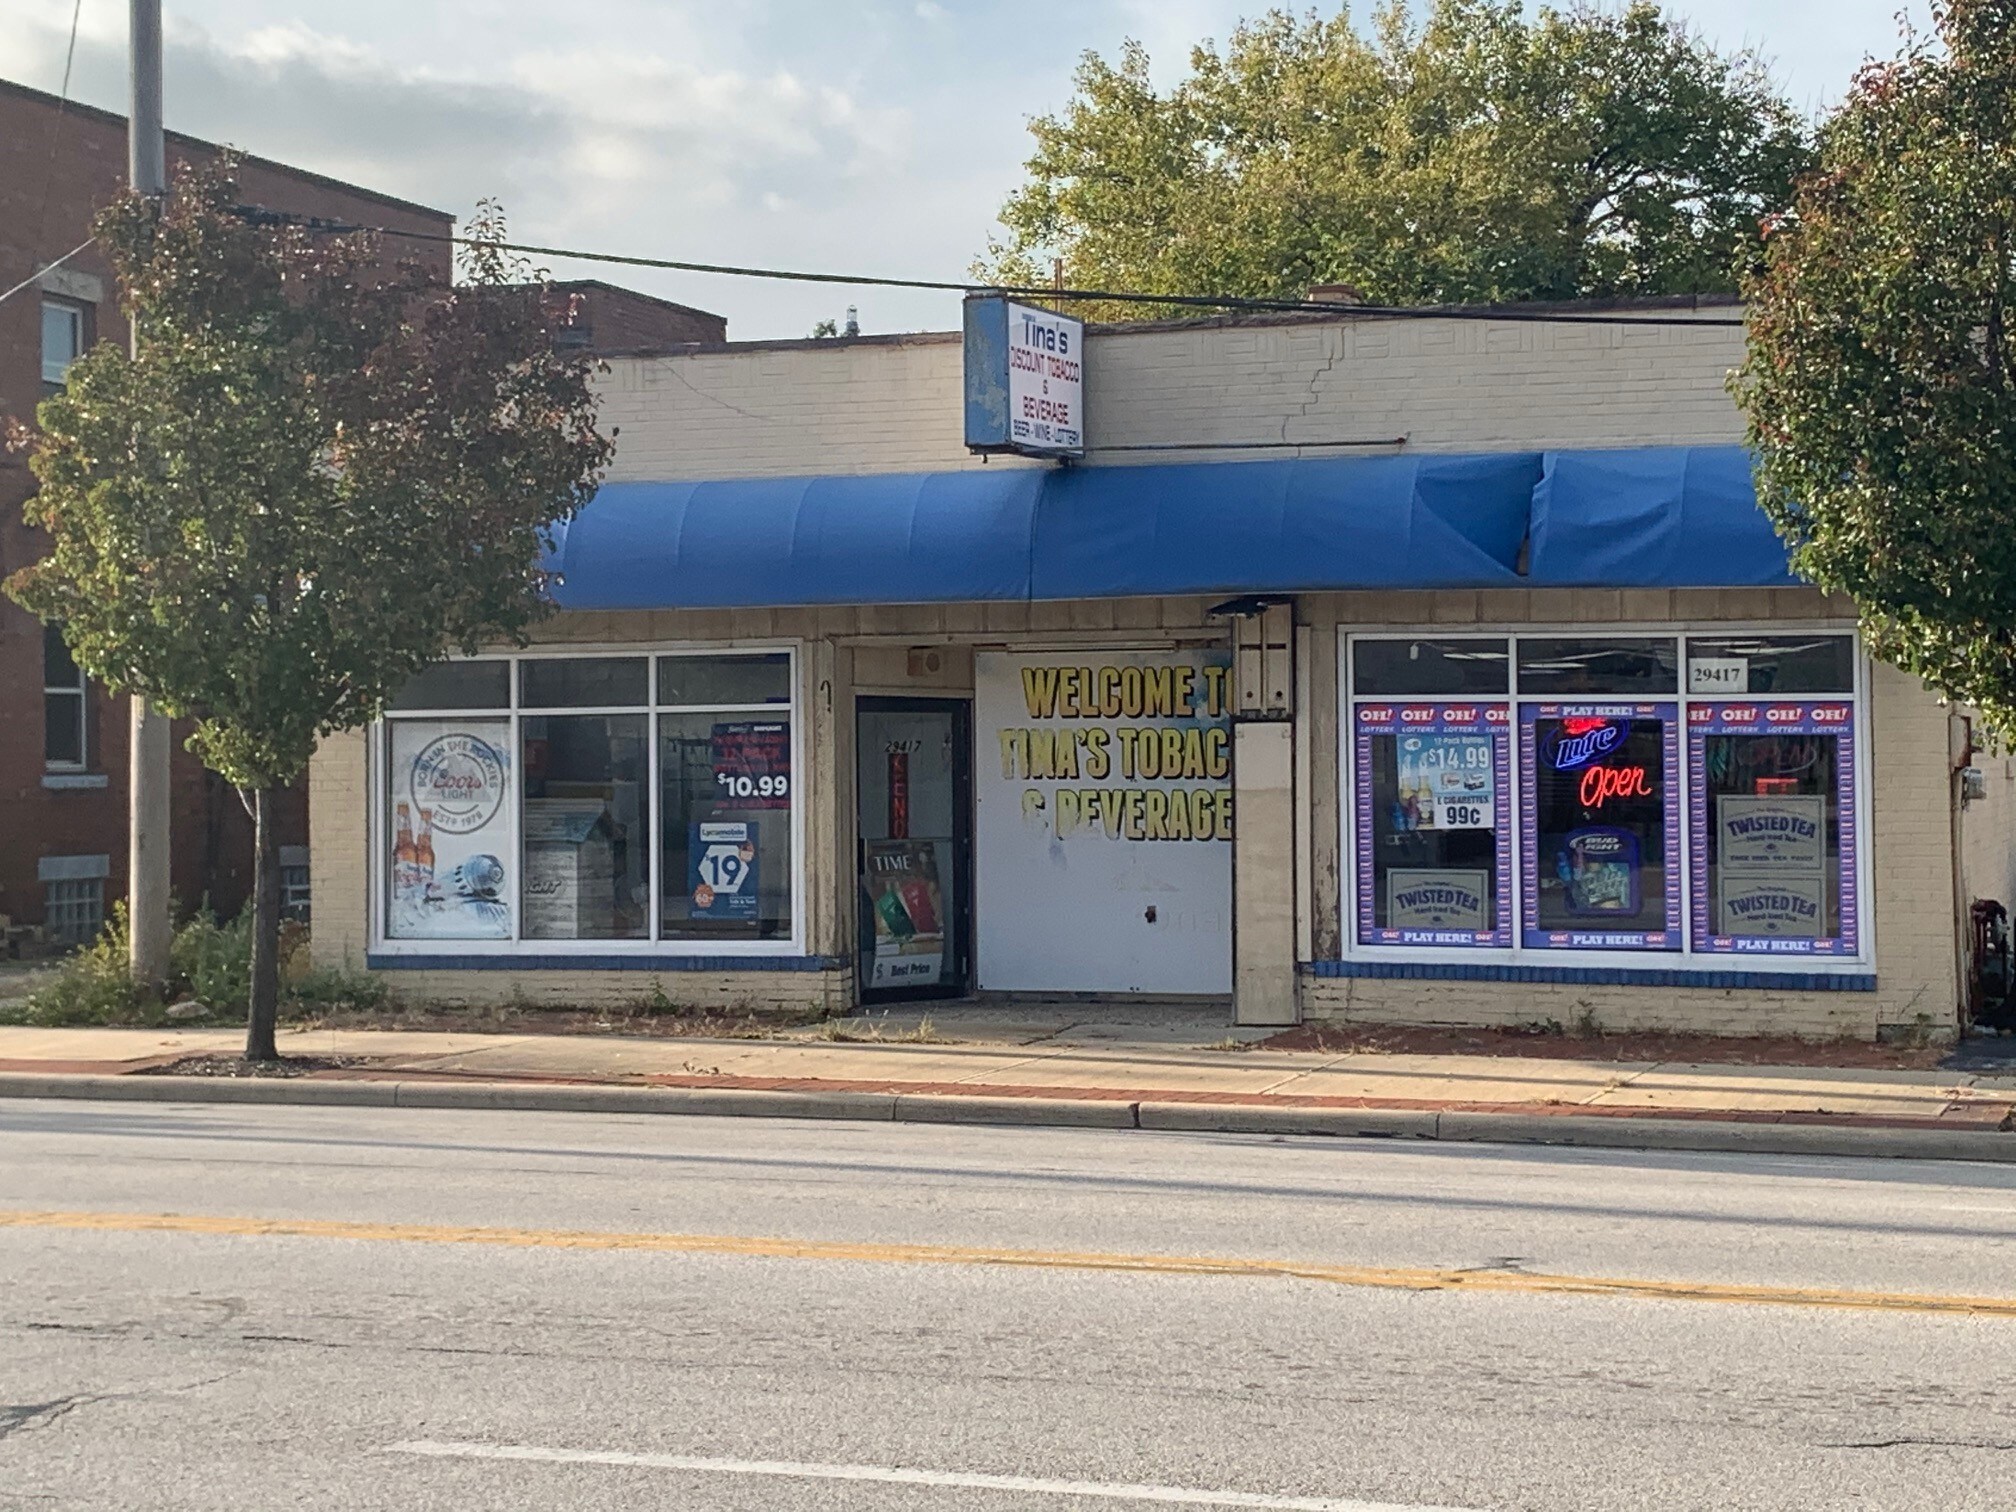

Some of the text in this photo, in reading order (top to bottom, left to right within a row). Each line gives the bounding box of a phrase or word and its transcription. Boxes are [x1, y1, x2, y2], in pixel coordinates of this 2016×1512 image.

[1022, 313, 1068, 354] Tina's
[1011, 346, 1079, 383] DISCOUNT TOBACCO
[1043, 380, 1048, 395] &
[1024, 396, 1069, 425] BEVERAGE
[1013, 419, 1030, 437] BEER
[1034, 423, 1050, 441] WINE
[1694, 668, 1740, 682] 29417
[1021, 666, 1195, 719] WELCOME
[1360, 708, 1393, 721] OH!
[1401, 708, 1434, 721] OH!
[1443, 708, 1476, 721] OH!
[1562, 706, 1633, 717] PLAY HERE!
[1721, 708, 1757, 721] OH!
[1766, 708, 1802, 721] OH!
[1811, 708, 1847, 721] OH!
[885, 741, 921, 753] 29417
[998, 728, 1110, 779] TINA'S
[1556, 726, 1617, 768] Lite
[1428, 746, 1489, 769] $14.99
[433, 774, 482, 789] Coors
[717, 773, 788, 797] $10.99
[1581, 766, 1652, 808] Open
[441, 790, 473, 799] LIGHT
[1447, 806, 1481, 826] 99¢
[1727, 815, 1816, 838] TWISTED TEA
[875, 856, 911, 871] TIME
[1395, 889, 1479, 911] TWISTED TEA
[1728, 895, 1817, 918] TWISTED TEA
[1404, 932, 1472, 943] PLAY HERE!
[1573, 935, 1643, 945] PLAY HERE!
[1737, 940, 1810, 950] PLAY HERE!
[891, 964, 909, 977] Best
[910, 963, 930, 974] Price
